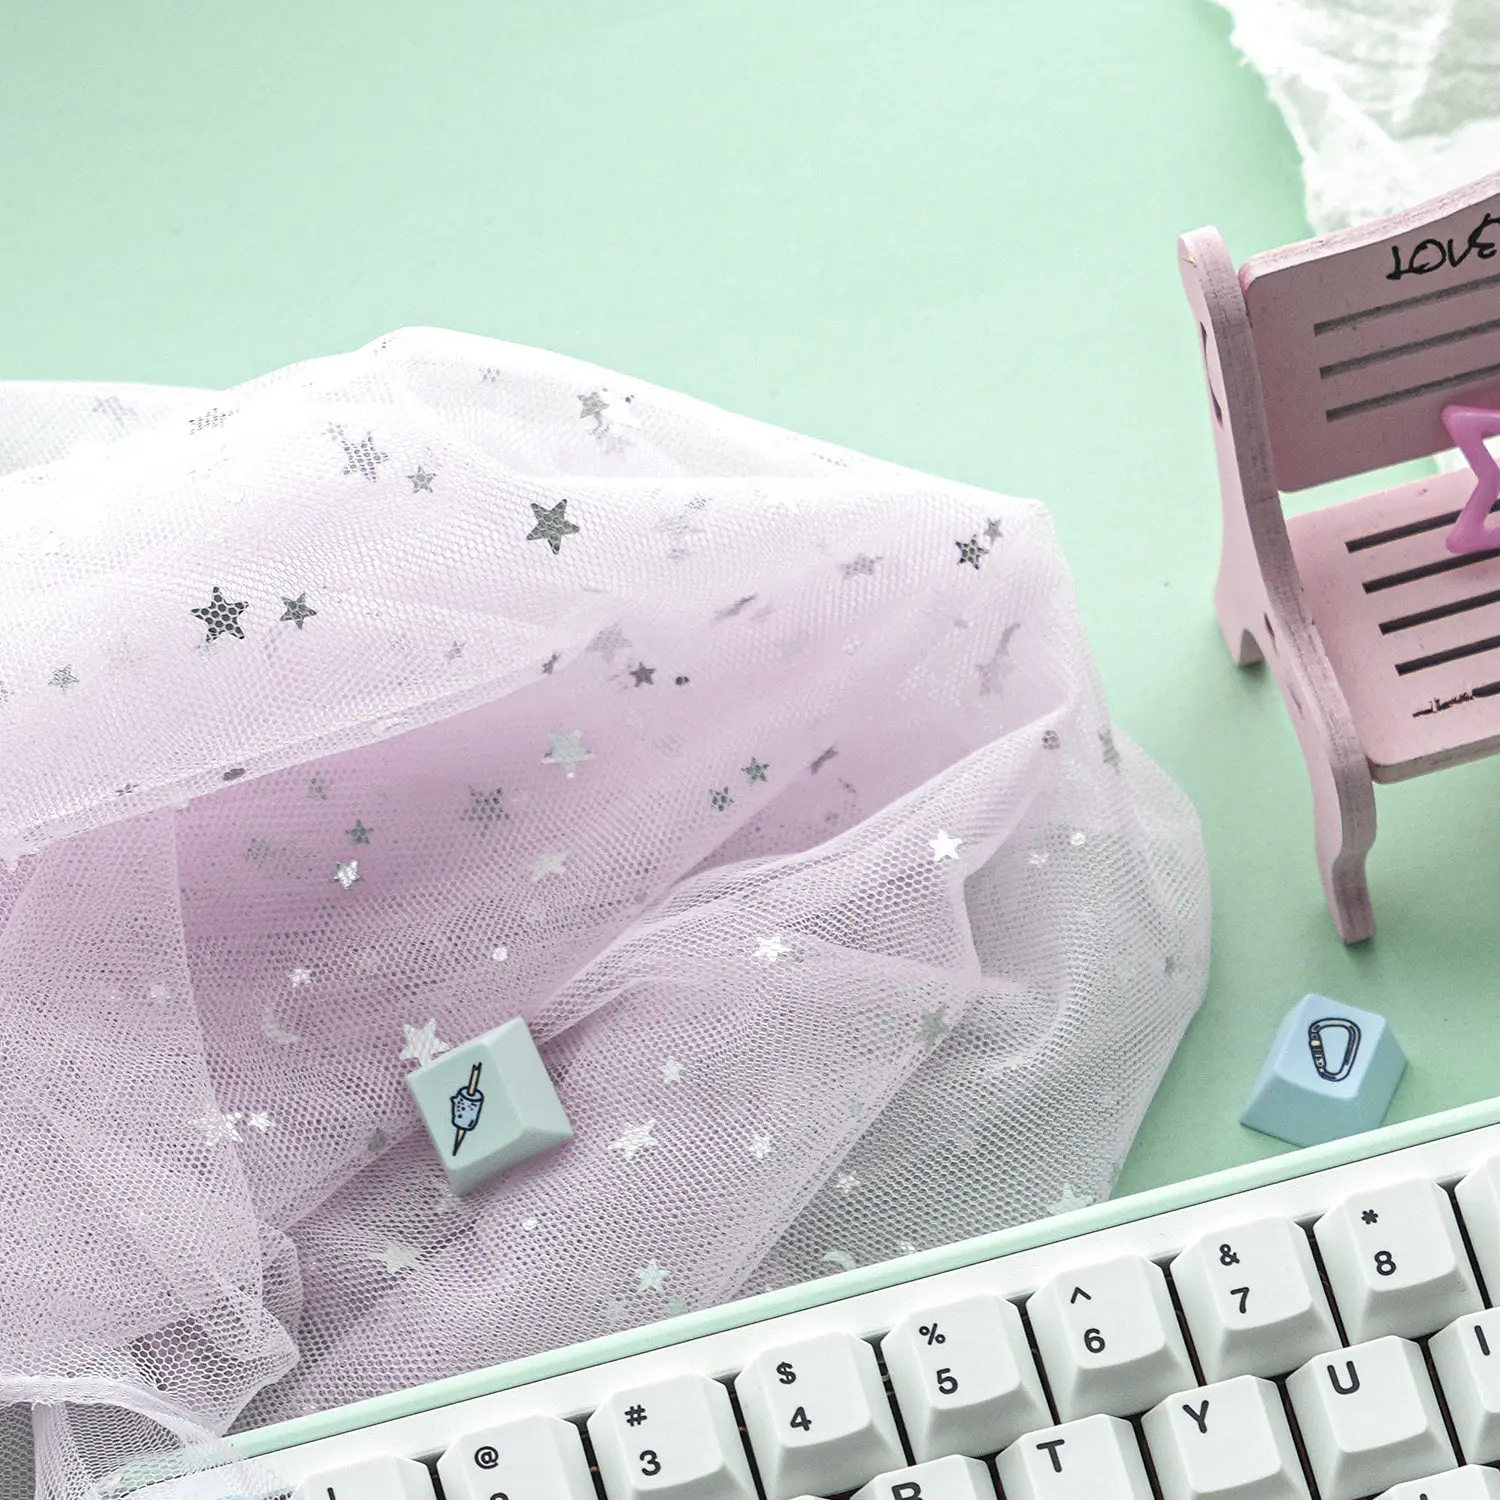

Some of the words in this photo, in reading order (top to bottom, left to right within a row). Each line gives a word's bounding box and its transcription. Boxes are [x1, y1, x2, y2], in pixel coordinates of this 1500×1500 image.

[1219, 1243, 1240, 1267] &
[1374, 1250, 1397, 1277] 8
[1229, 1286, 1250, 1314] 7
[918, 1322, 946, 1346] %
[1083, 1327, 1106, 1354] 6
[776, 1361, 797, 1385] $
[936, 1367, 959, 1395] 5
[1326, 1360, 1361, 1395] U
[624, 1404, 648, 1427] #
[789, 1406, 812, 1432] 4
[1182, 1399, 1210, 1434] Y
[474, 1445, 499, 1470] @
[639, 1449, 662, 1477] 3
[1036, 1438, 1066, 1473] T
